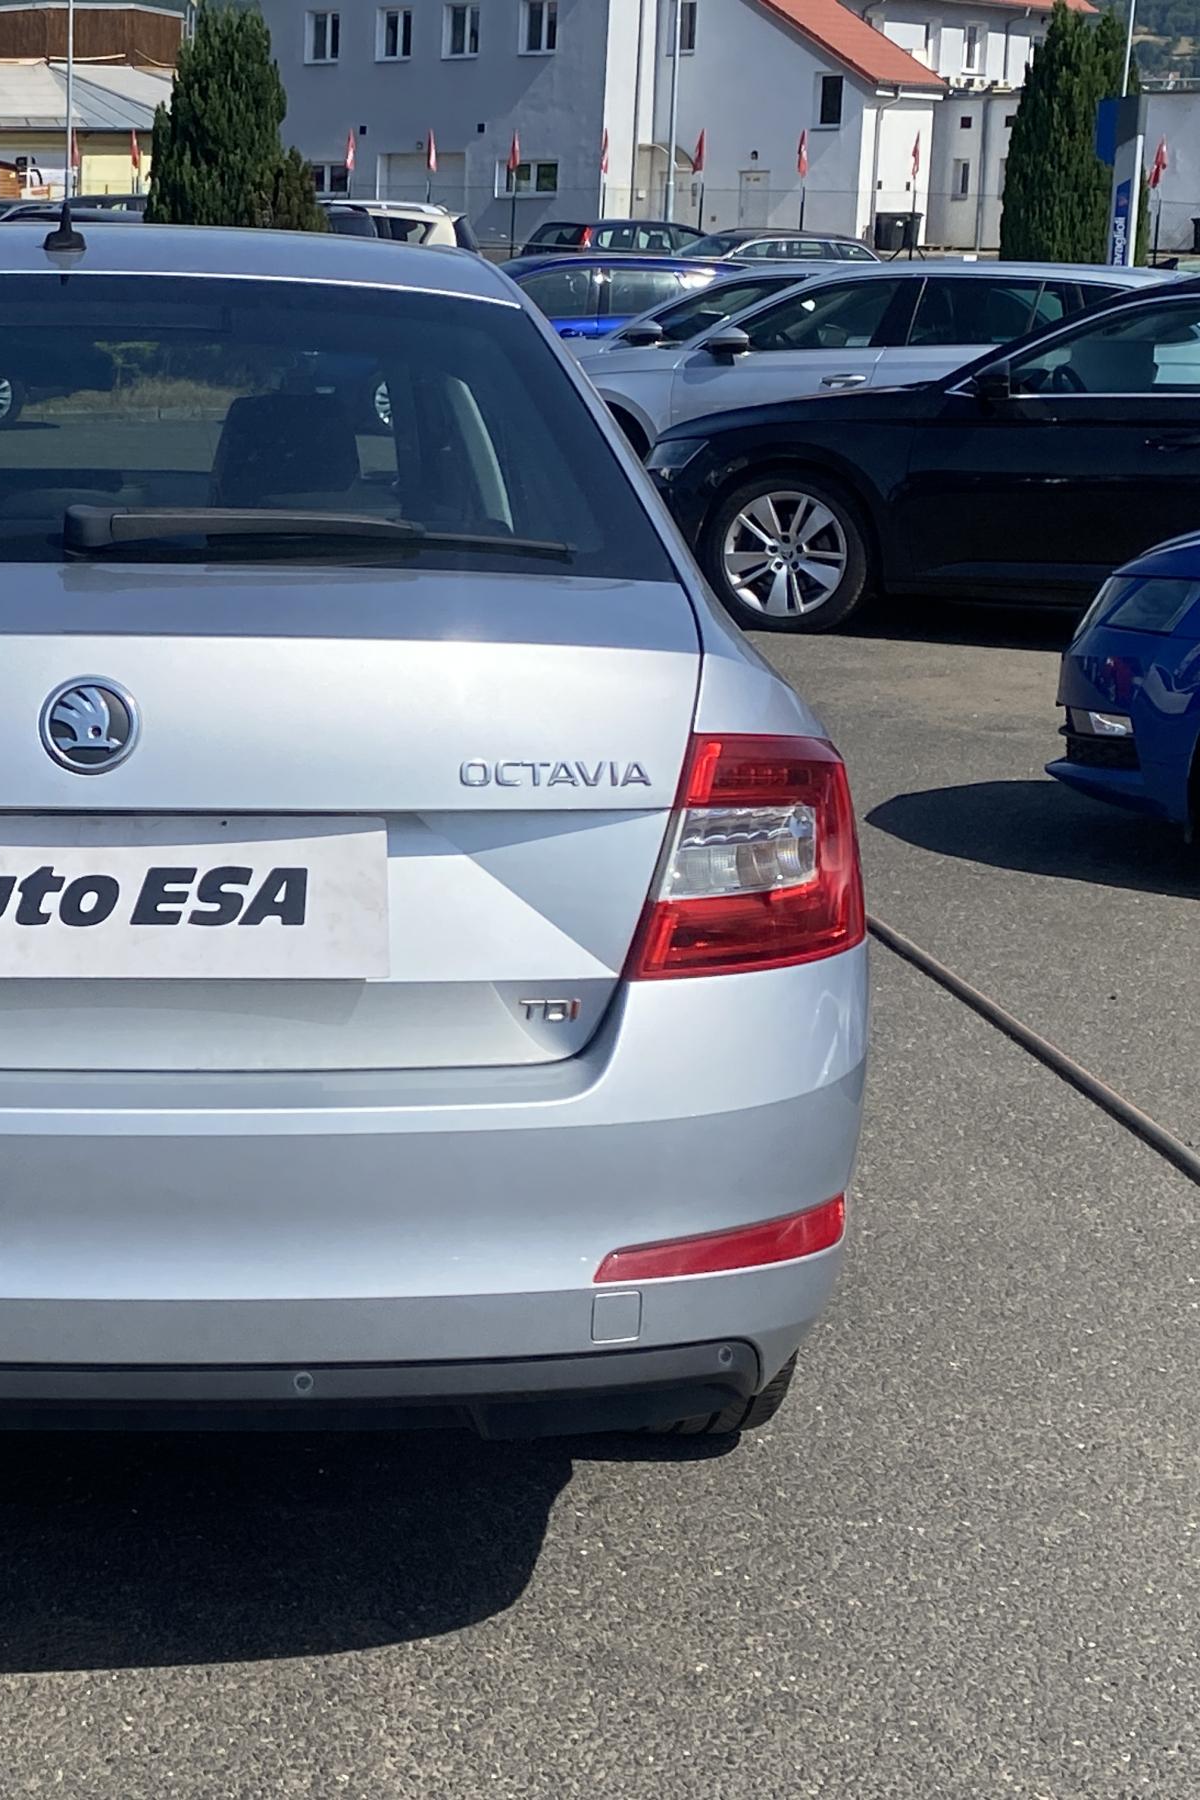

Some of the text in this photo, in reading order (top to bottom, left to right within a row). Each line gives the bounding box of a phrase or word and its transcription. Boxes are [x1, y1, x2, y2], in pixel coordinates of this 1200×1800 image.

[459, 758, 652, 787] OCTAVIA
[129, 867, 308, 926] ESA
[519, 999, 581, 1022] TDI
